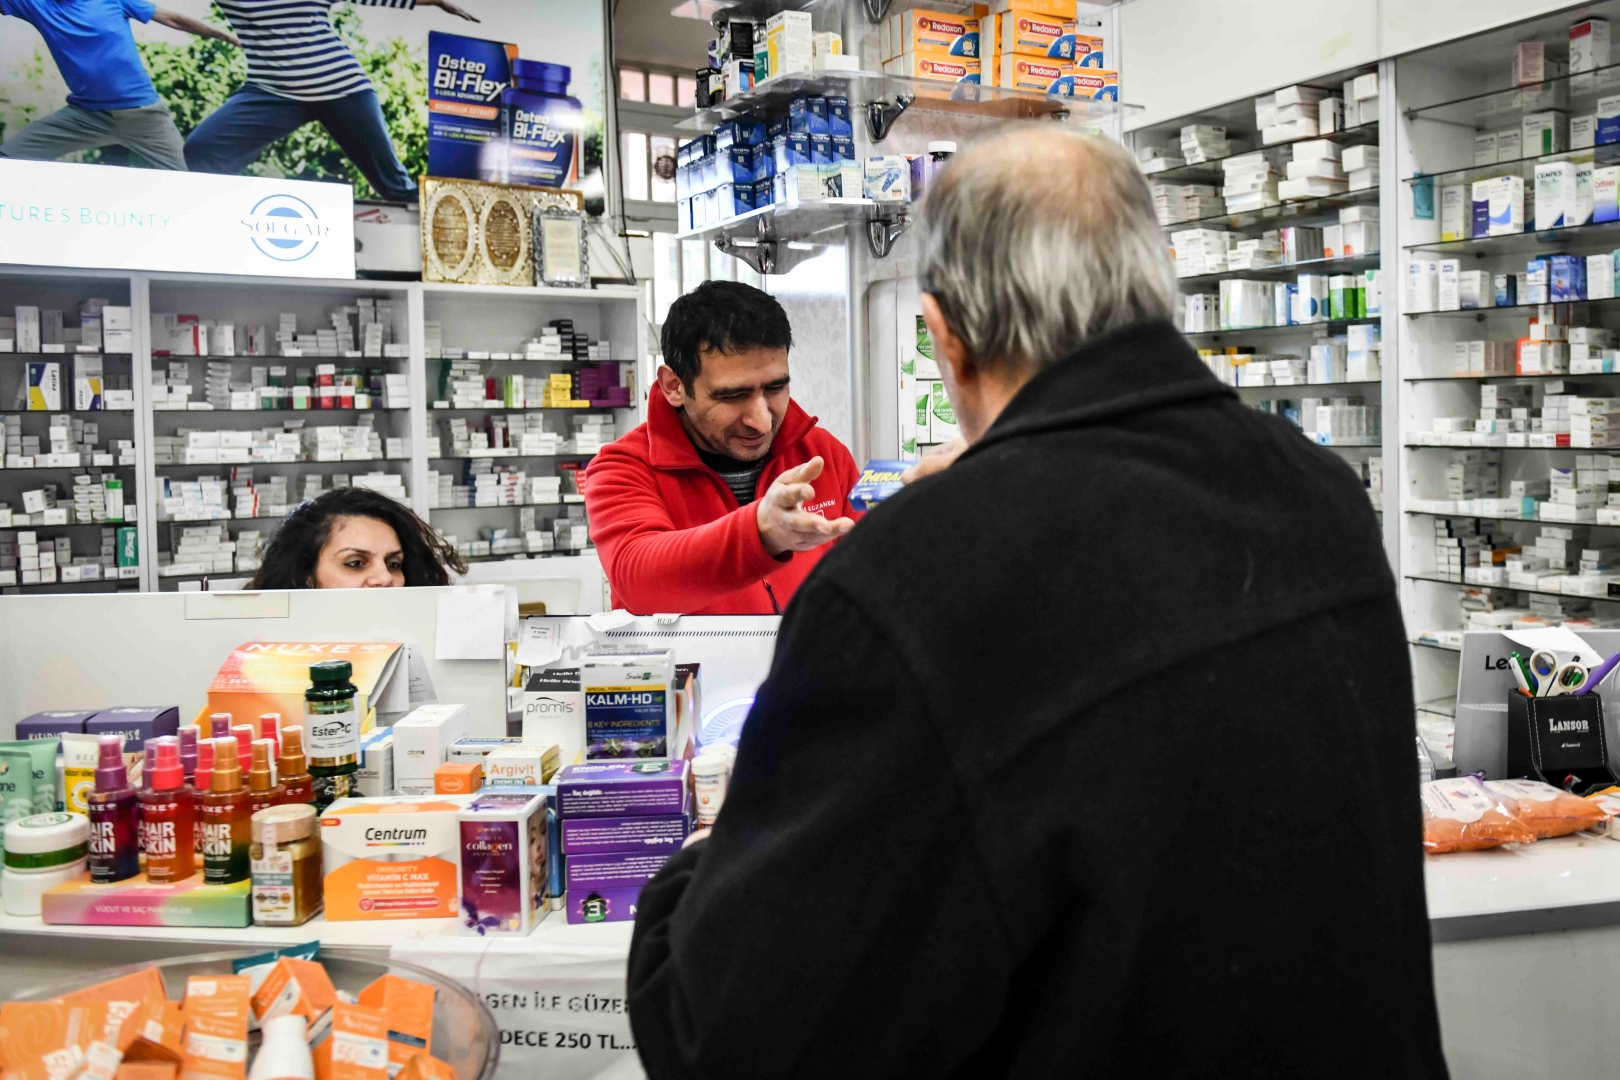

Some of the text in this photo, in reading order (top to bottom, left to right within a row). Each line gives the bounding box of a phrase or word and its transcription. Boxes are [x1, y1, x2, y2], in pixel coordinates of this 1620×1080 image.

[932, 22, 963, 34] Redoxon
[1032, 23, 1061, 36] Redoxon
[1075, 42, 1090, 52] oxon
[438, 54, 486, 74] Osteo
[933, 64, 964, 76] Redoxon
[1030, 65, 1060, 77] Redoxon
[434, 68, 507, 102] Bi-Flex
[1074, 76, 1103, 87] Redoxon
[515, 110, 550, 124] Osteo
[513, 122, 565, 148] Bi-Flex
[80, 207, 171, 228] BOUNTY
[241, 219, 329, 237] SOLGAR
[246, 643, 356, 654] NUXE
[587, 693, 652, 706] KALM-HD
[526, 700, 573, 716] promis
[312, 722, 352, 737] Ester-C
[610, 720, 661, 728] INGREDIENTS
[1549, 718, 1589, 731] LANSOR
[490, 764, 535, 778] Argivit
[365, 828, 427, 841] Centrum
[466, 841, 513, 853] collagen
[409, 873, 429, 881] MAX
[484, 993, 527, 1010] GEN
[567, 993, 630, 1015] GÜZE
[555, 1032, 592, 1049] 250
